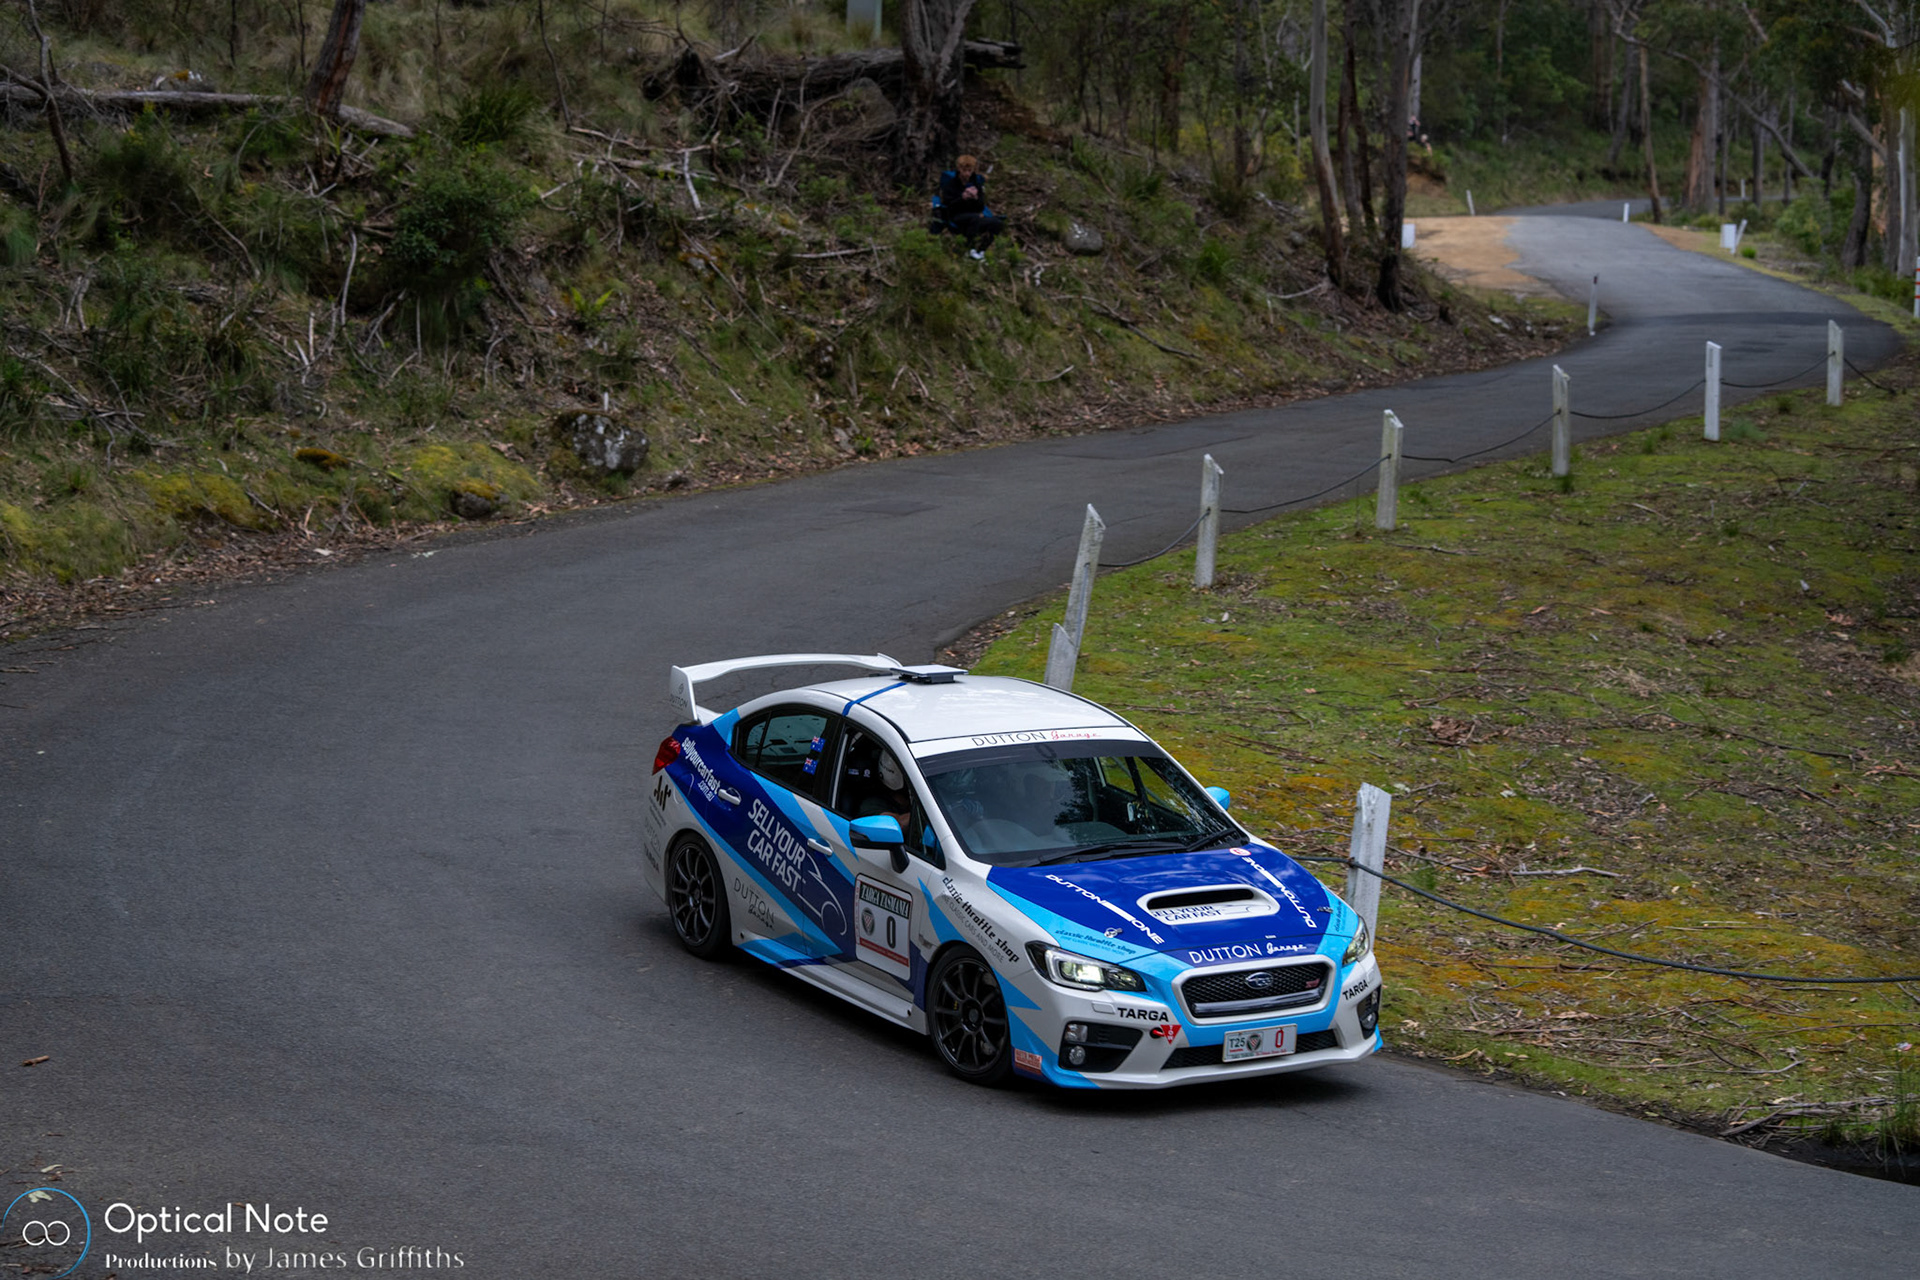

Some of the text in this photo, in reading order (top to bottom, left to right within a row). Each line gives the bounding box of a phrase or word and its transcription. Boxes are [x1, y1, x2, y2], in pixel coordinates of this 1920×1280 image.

[971, 730, 1102, 747] DUTTON Garage
[681, 736, 720, 795] sellyourcarfast
[747, 798, 806, 870] SELL YOUR
[747, 828, 801, 893] CAR FAST
[734, 877, 774, 925] DUTTON
[942, 877, 1020, 963] classic throttle shop
[1045, 874, 1165, 945] DUTTON ONE
[1164, 904, 1222, 922] CAR FAST
[1280, 884, 1317, 928] DUTTON
[886, 915, 896, 949] 0
[1188, 942, 1307, 964] DUTTON Garage
[1342, 979, 1369, 1001] TARGA
[1117, 1007, 1169, 1022] TARGA
[1229, 1029, 1284, 1048] T25 0
